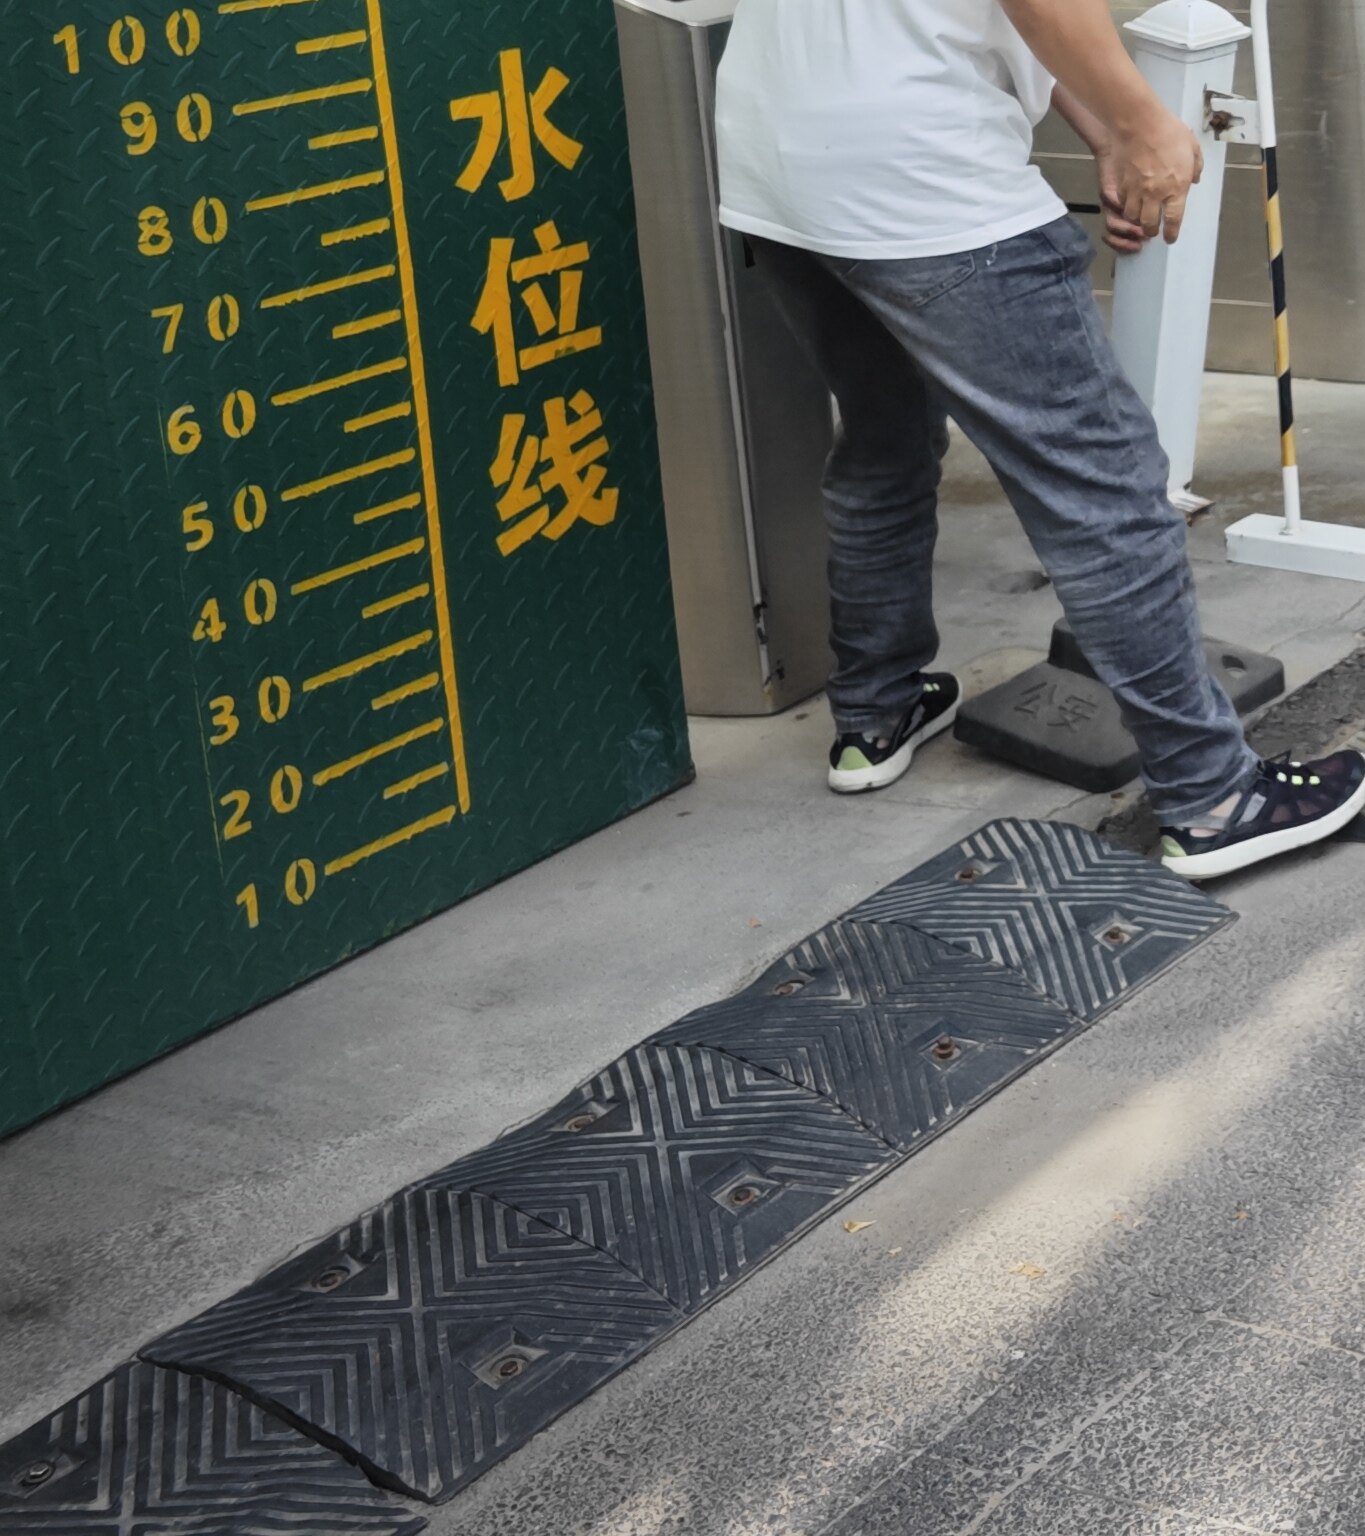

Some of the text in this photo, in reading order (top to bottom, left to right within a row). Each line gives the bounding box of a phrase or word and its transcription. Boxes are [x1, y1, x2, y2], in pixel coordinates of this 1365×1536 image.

[53, 8, 200, 74] 100
[119, 93, 212, 155] 90
[138, 196, 228, 256] 80
[152, 293, 240, 353] 70
[449, 48, 620, 556] 水位线
[167, 390, 256, 455] 60
[181, 485, 266, 552] 50
[193, 578, 277, 643] 40
[210, 676, 290, 746] 30
[220, 765, 302, 841] 20
[236, 858, 315, 928] 10
